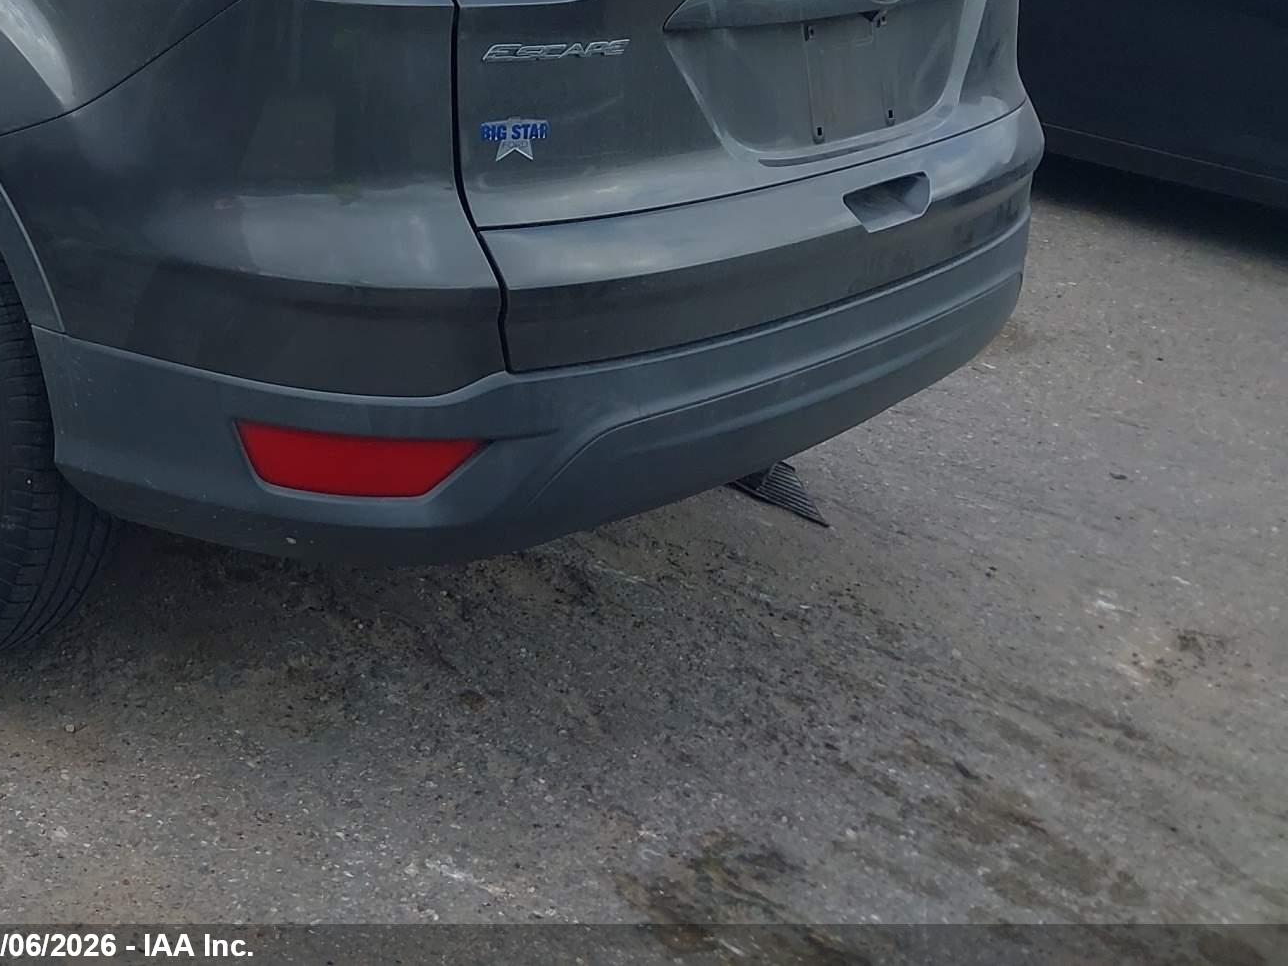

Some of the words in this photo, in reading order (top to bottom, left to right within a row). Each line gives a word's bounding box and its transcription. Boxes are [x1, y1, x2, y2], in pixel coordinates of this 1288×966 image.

[482, 38, 630, 63] ESCAPE
[480, 123, 507, 141] BIG
[511, 122, 548, 140] STAR
